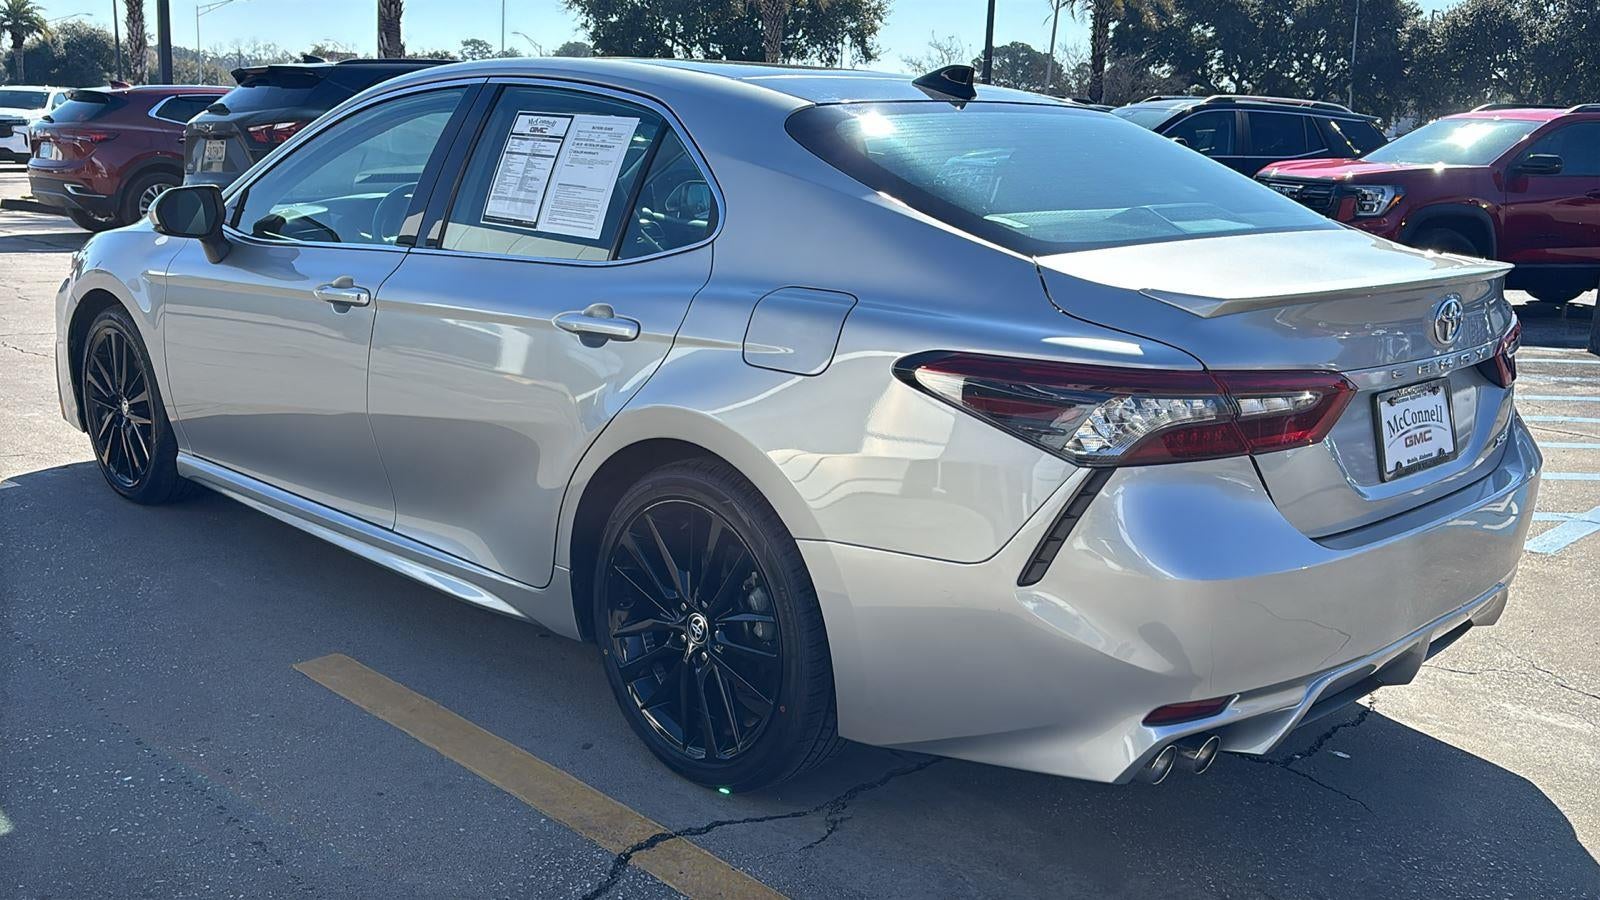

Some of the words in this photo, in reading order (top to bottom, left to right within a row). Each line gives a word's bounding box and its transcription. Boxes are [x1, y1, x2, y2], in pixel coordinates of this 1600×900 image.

[1392, 348, 1486, 378] CAMRY
[1387, 404, 1443, 438] McConnell
[1405, 430, 1432, 447] GMC
